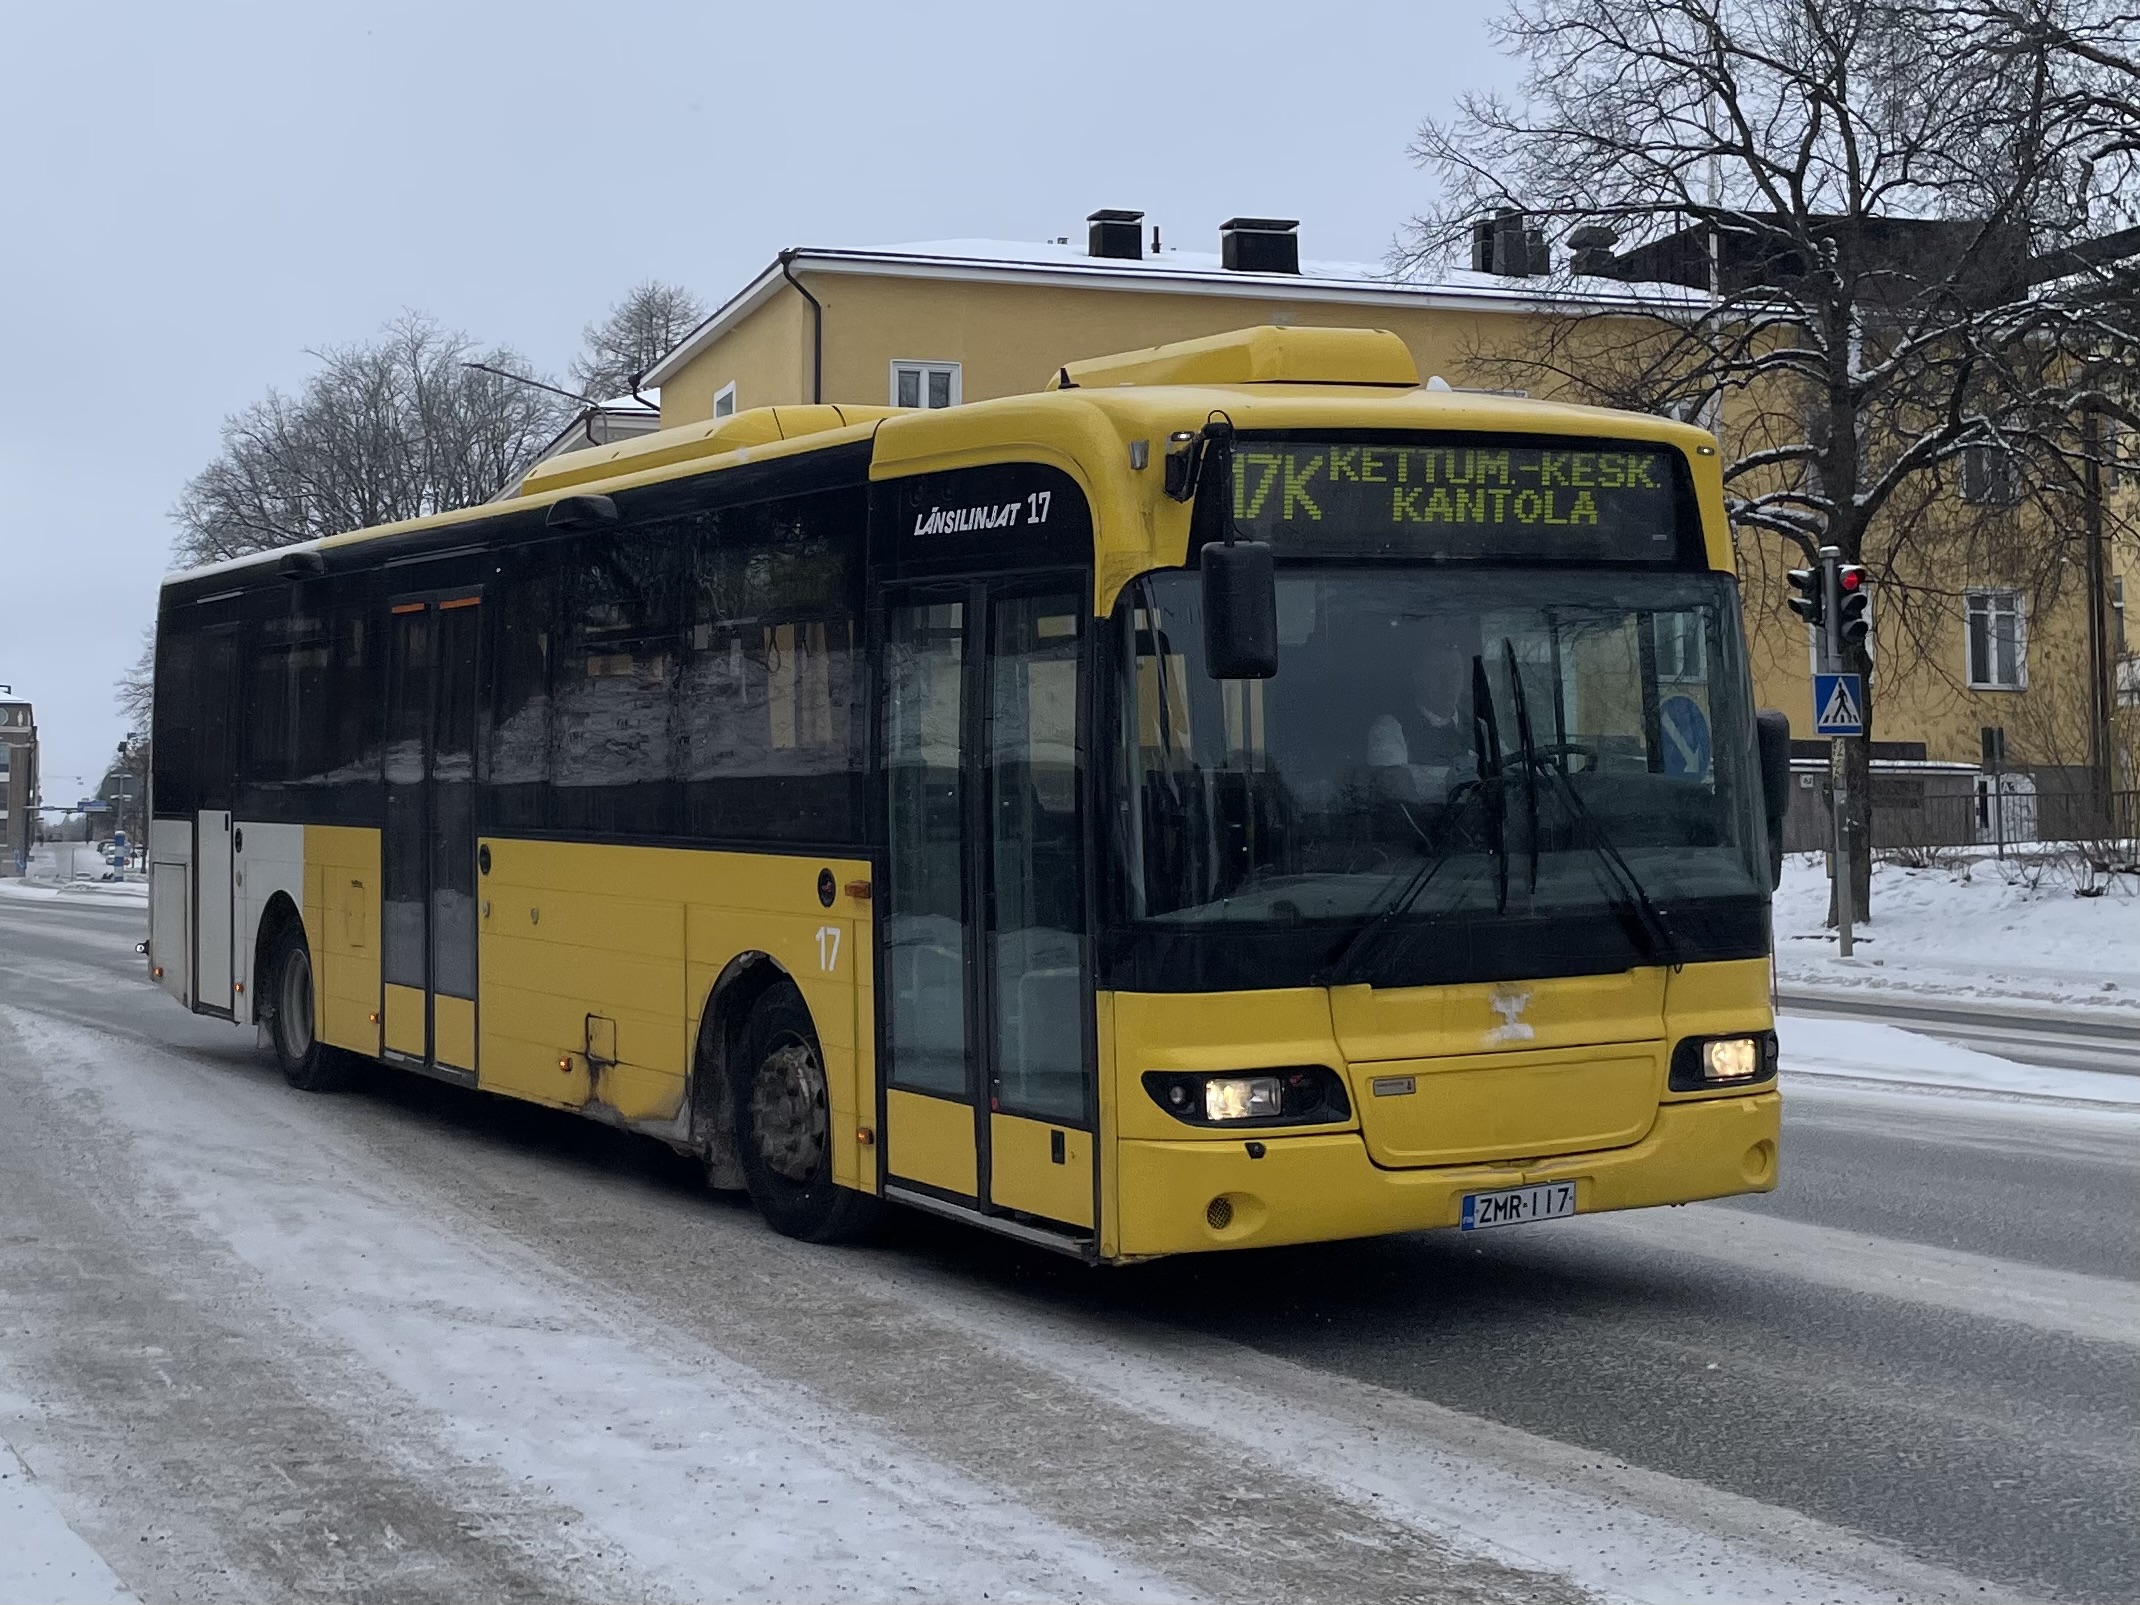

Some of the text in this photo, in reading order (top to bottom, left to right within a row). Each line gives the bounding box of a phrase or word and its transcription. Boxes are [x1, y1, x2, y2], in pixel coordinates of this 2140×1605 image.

[1232, 453, 1323, 520] 17K
[1392, 487, 1598, 525] KANTOLA
[914, 491, 1051, 536] LÄNSILINJAT 17
[815, 926, 841, 972] 17
[1479, 1187, 1570, 1224] ZMR-117
